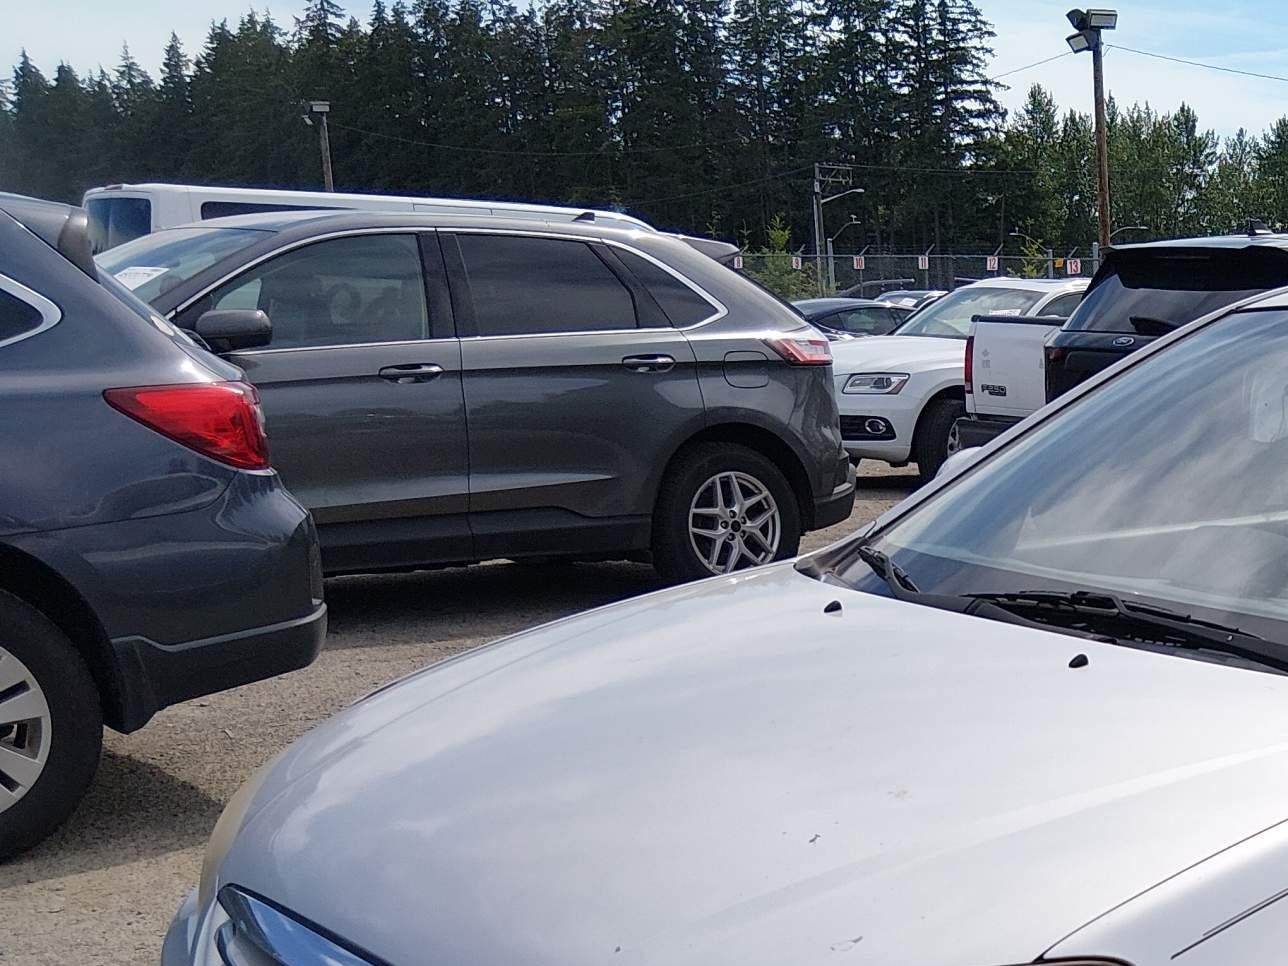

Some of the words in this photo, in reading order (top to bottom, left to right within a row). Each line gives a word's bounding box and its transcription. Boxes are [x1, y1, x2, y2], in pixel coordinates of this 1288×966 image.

[855, 257, 864, 269] 10
[989, 257, 997, 270] 12
[1069, 260, 1080, 273] 13
